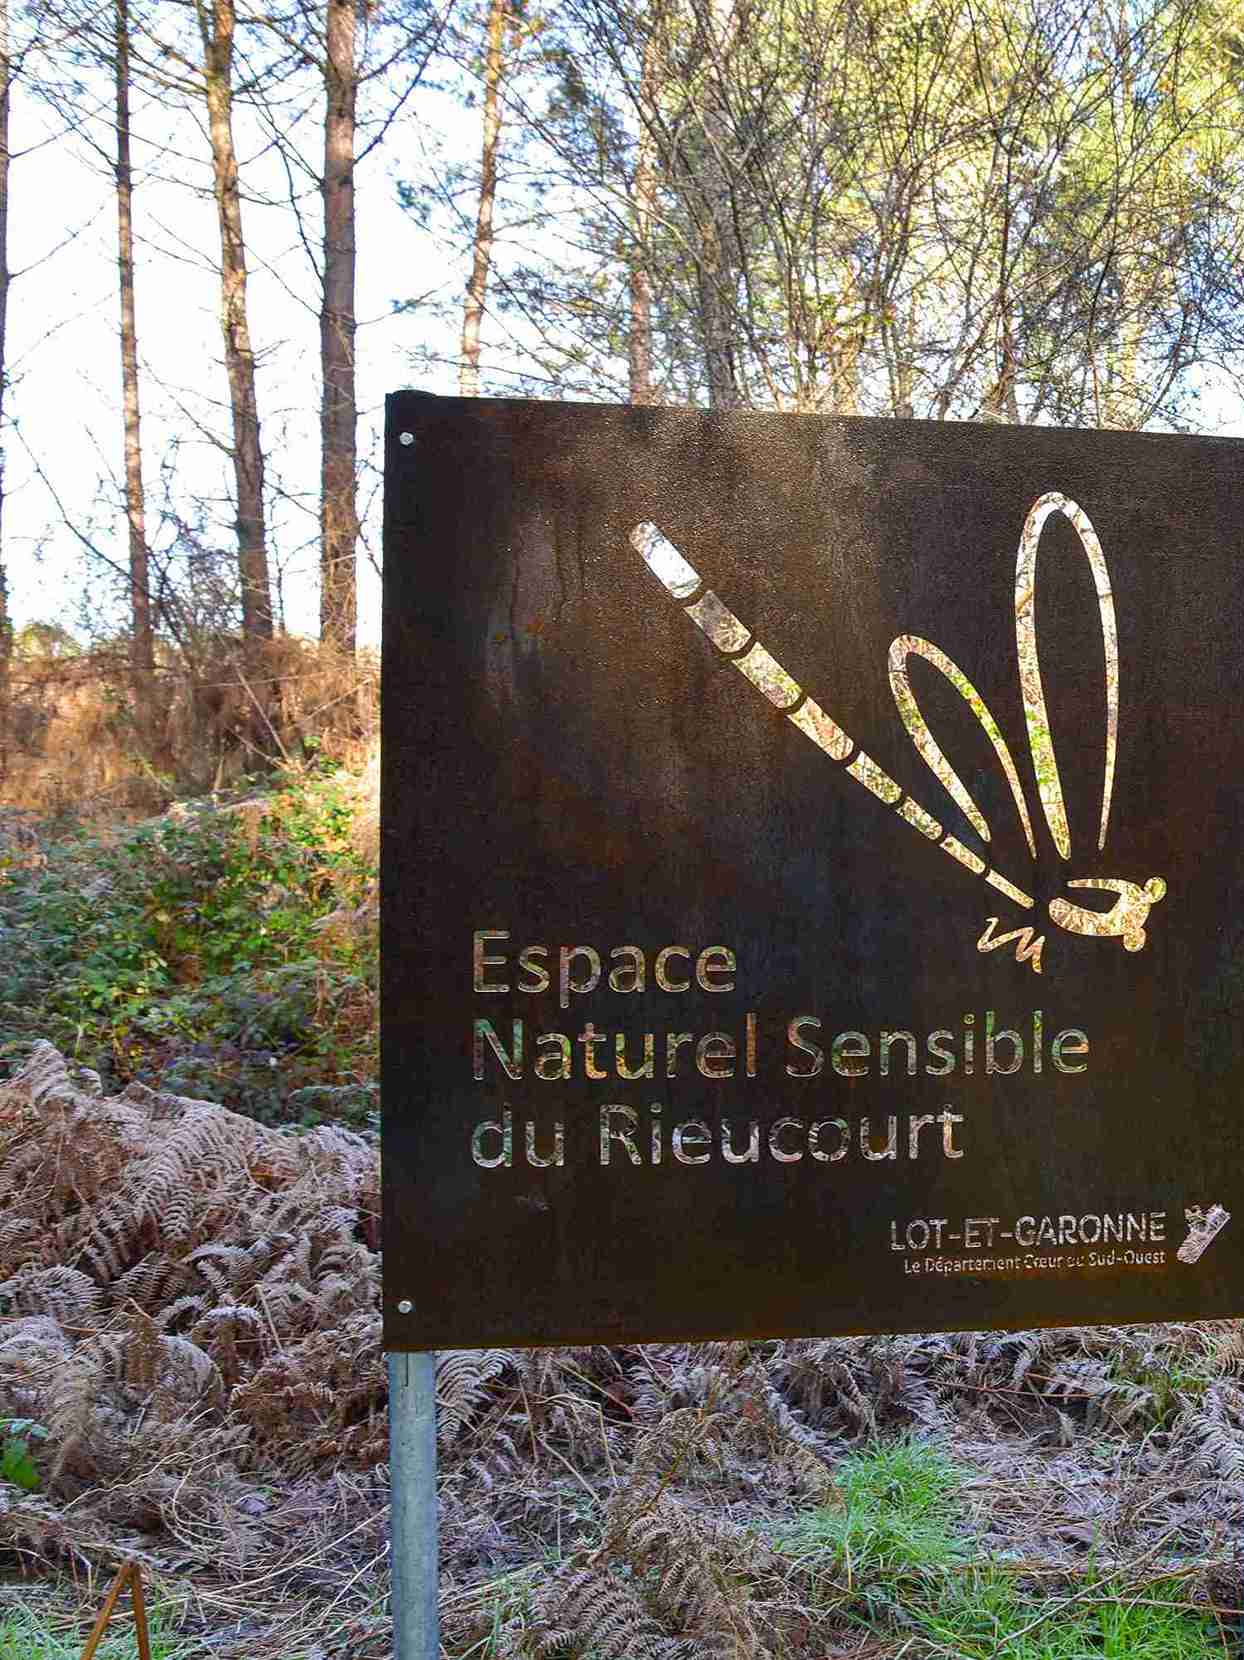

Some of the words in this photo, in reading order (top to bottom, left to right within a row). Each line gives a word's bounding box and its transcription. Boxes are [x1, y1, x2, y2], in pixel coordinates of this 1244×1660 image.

[472, 929, 737, 1008] Espace
[473, 1012, 758, 1081] Naturel
[785, 1010, 1088, 1077] Sensible
[471, 1103, 565, 1168] du
[600, 1103, 964, 1165] Rieucourt
[890, 1212, 1167, 1250] LOT-ET-GARONNE
[904, 1258, 920, 1274] Le
[925, 1254, 1022, 1276] Département
[1089, 1249, 1166, 1267] Sud-Ouest
